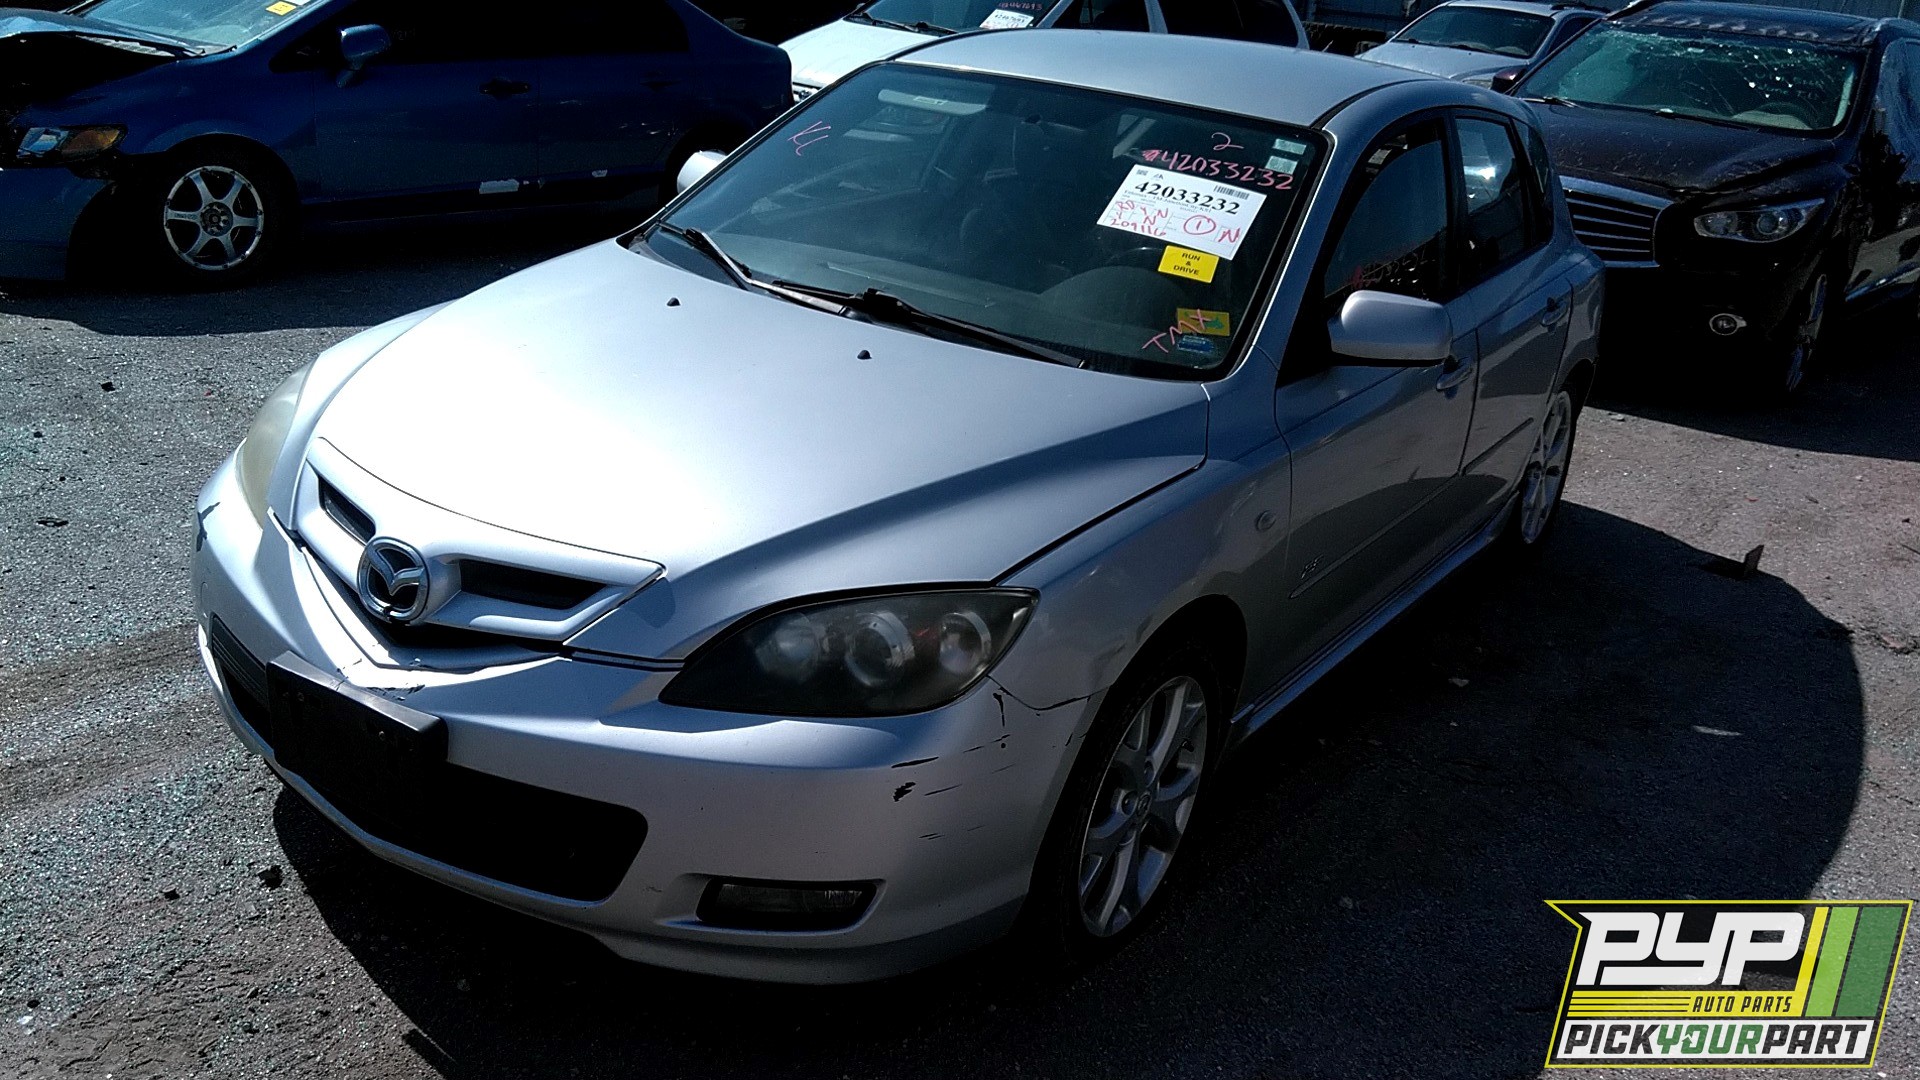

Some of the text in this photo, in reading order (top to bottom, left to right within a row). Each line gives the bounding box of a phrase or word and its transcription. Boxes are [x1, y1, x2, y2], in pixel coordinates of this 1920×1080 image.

[1211, 131, 1245, 151] 2
[1134, 181, 1241, 215] 42033232
[1181, 252, 1201, 261] RUN
[1173, 264, 1201, 276] DRIVE
